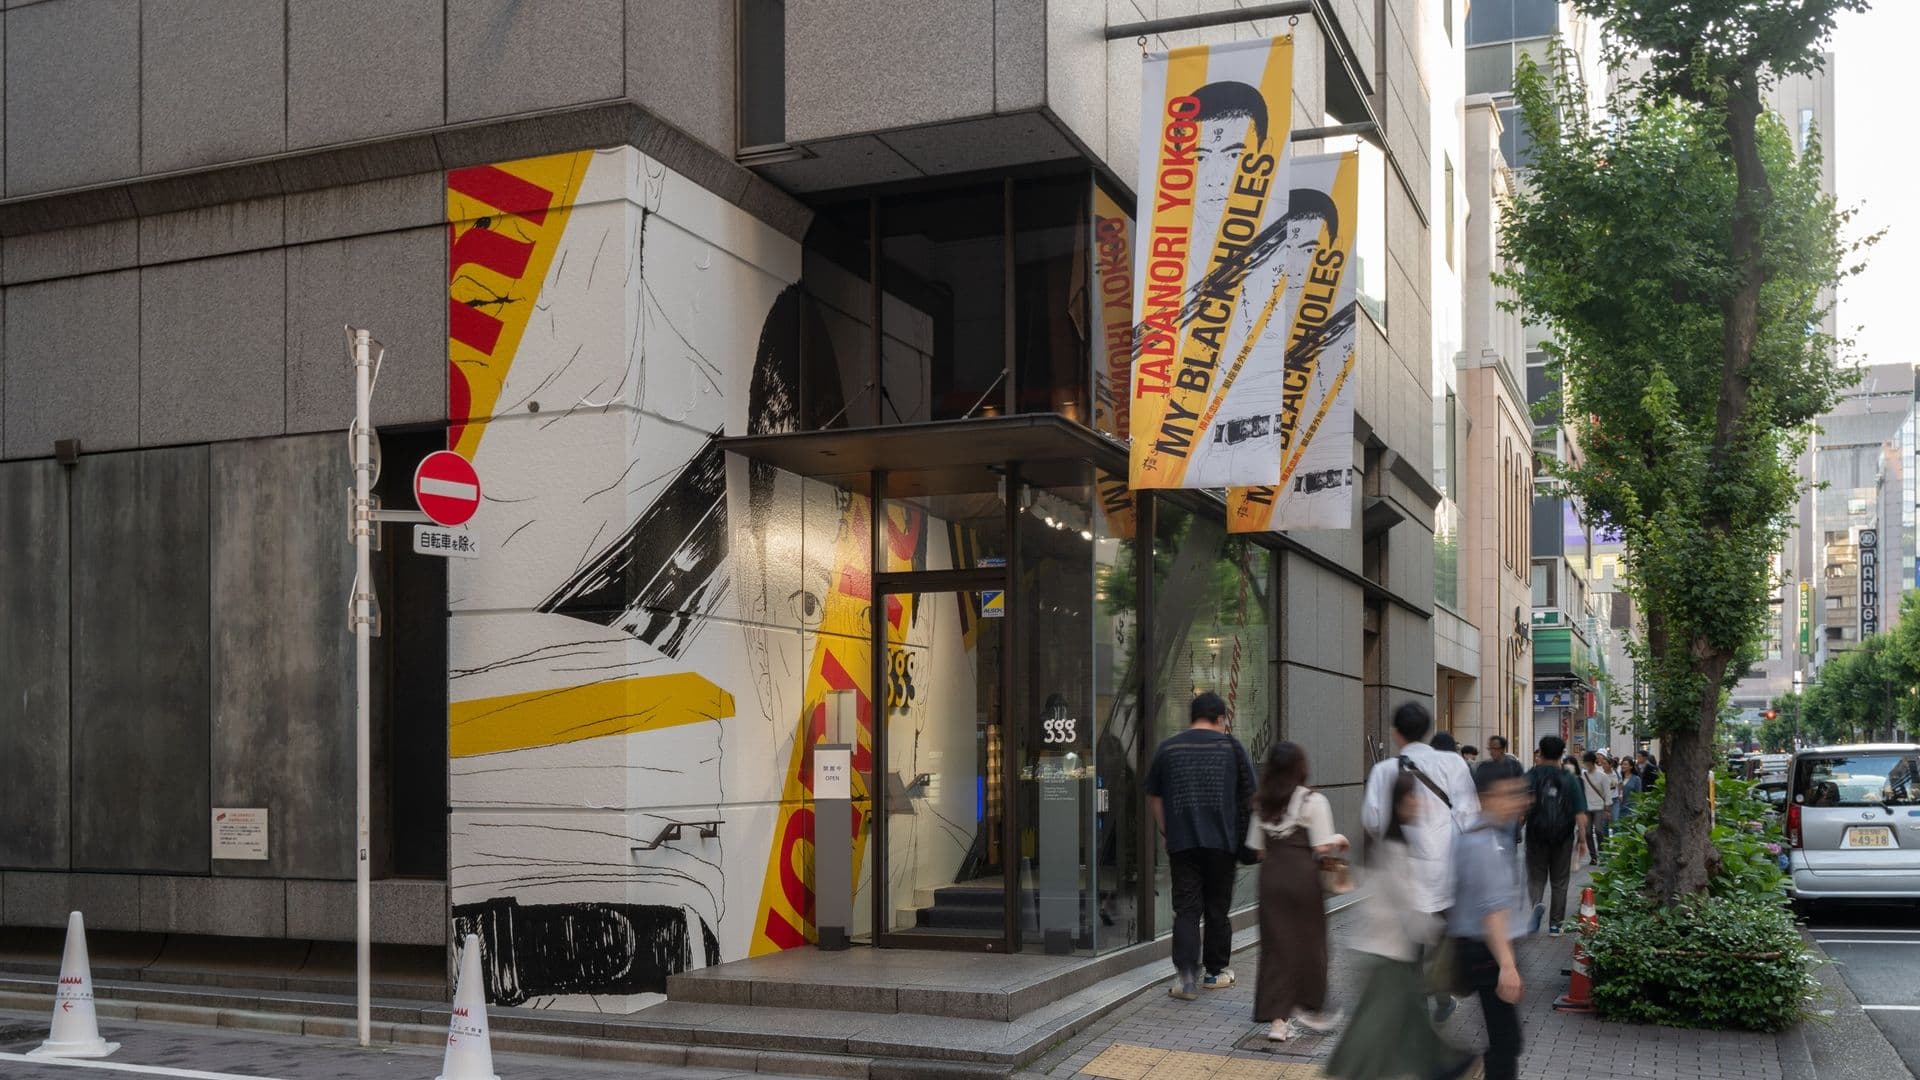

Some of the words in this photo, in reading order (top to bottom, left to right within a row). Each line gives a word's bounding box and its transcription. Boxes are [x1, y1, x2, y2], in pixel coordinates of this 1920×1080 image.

[1157, 96, 1201, 212] YOKOO
[1214, 153, 1275, 264] HOLES
[1136, 226, 1188, 399] TADANORI
[1176, 276, 1240, 393] BLACK
[1292, 249, 1345, 345] HOLES
[1156, 399, 1199, 458] MY
[421, 531, 476, 552] 自転車を除く
[1044, 719, 1076, 743] ggg
[1858, 836, 1887, 845] 49-18
